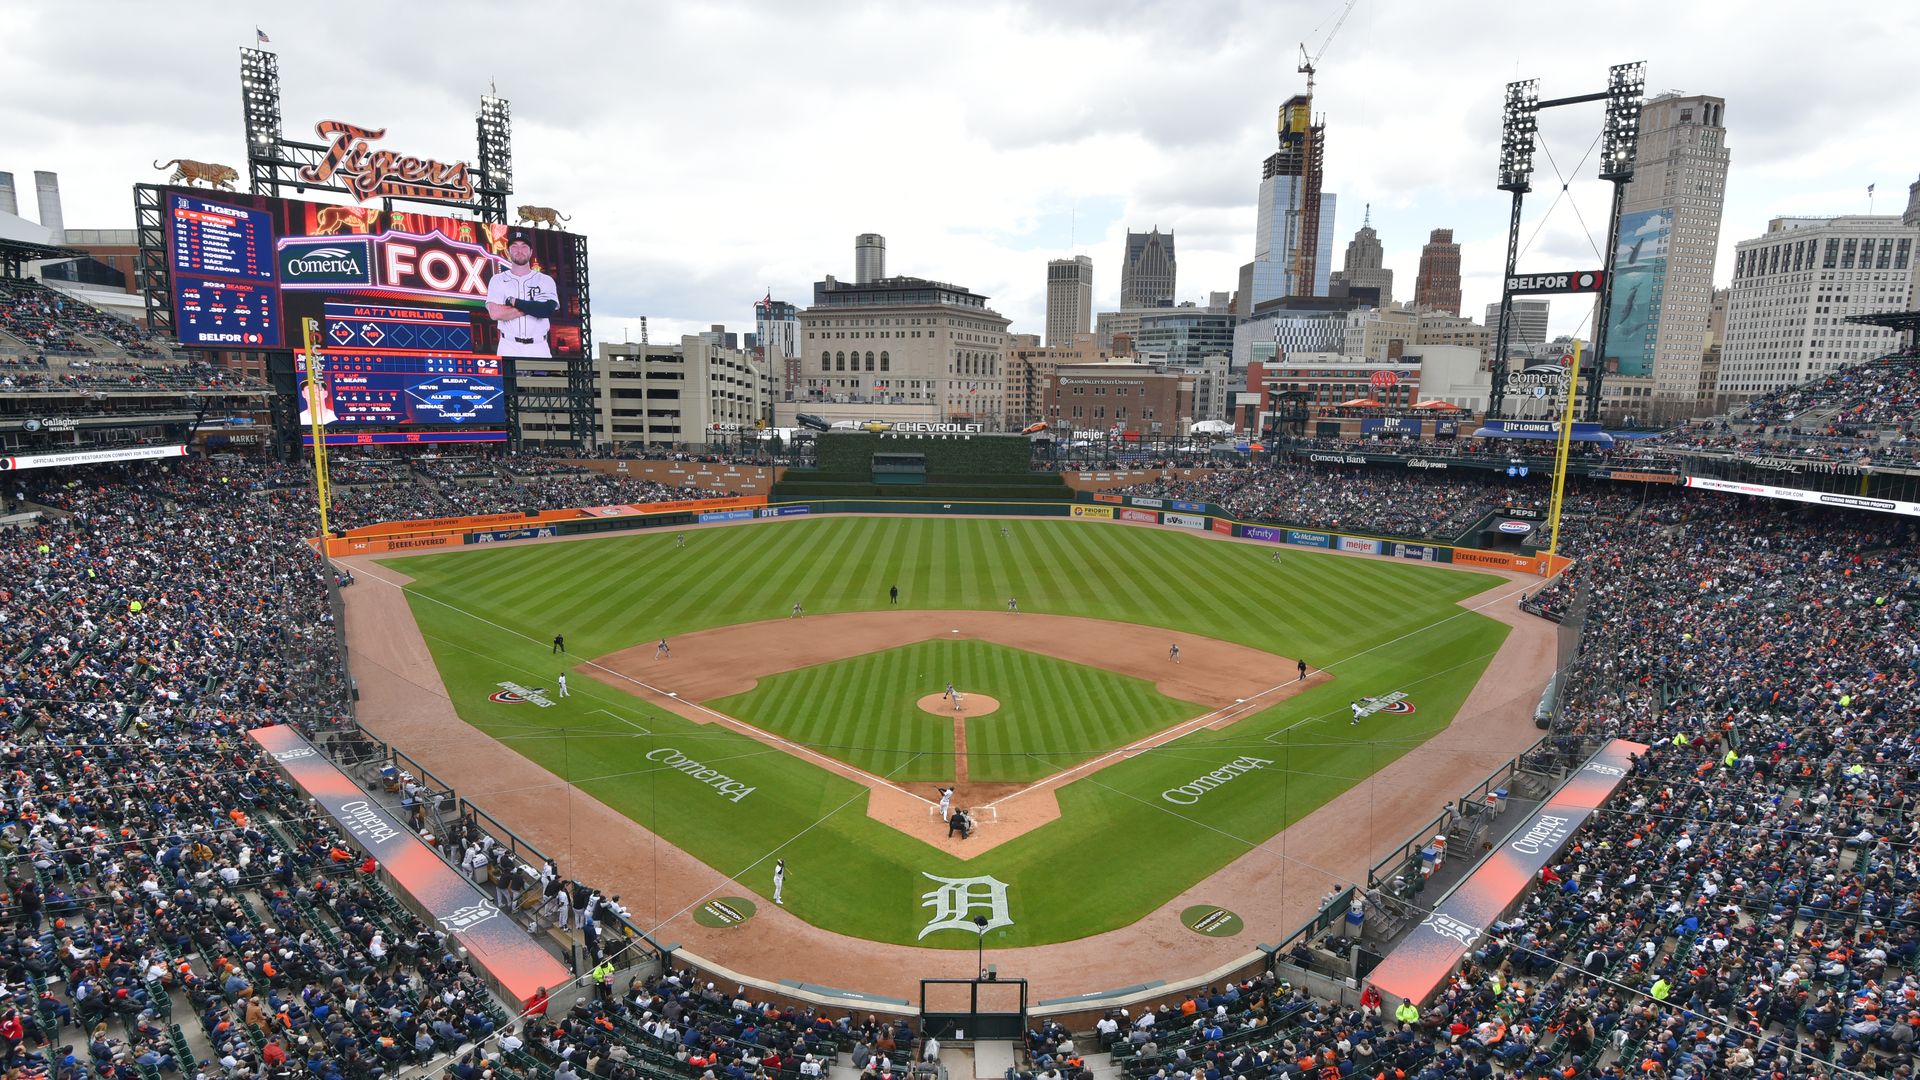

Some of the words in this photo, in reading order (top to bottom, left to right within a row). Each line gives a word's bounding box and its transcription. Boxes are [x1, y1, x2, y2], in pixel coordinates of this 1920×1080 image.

[300, 120, 474, 204] Tigers
[202, 204, 248, 219] TIGERS
[385, 242, 488, 296] FOX
[226, 283, 253, 291] SEASON
[1508, 275, 1568, 290] BELFOR
[354, 308, 386, 316] MATT
[388, 309, 444, 319] VIERLING
[199, 333, 241, 342] BELFOR
[309, 320, 324, 391] ROCKET
[477, 360, 498, 368] 0-2
[1558, 344, 1574, 413] ROCKET
[41, 418, 79, 427] Gallagher
[896, 422, 984, 432] CHEVROLET
[1384, 417, 1400, 428] Lite
[1504, 421, 1520, 432] Lite
[229, 435, 258, 443] MARKET
[1073, 428, 1104, 441] meijer
[1346, 456, 1367, 464] Bank
[1407, 458, 1430, 469] Bally
[1804, 463, 1828, 473] TIGER
[1837, 464, 1857, 475] CLUB
[1870, 501, 1894, 509] PROPERTY
[762, 508, 778, 517] DTE
[1510, 509, 1537, 517] PEPSI
[1247, 528, 1273, 540] xfinity
[1301, 533, 1325, 542] McLaren
[1346, 540, 1372, 551] meijer
[341, 814, 366, 836] PARK
[1543, 828, 1567, 849] PARK
[712, 901, 743, 921] PENNINGTON
